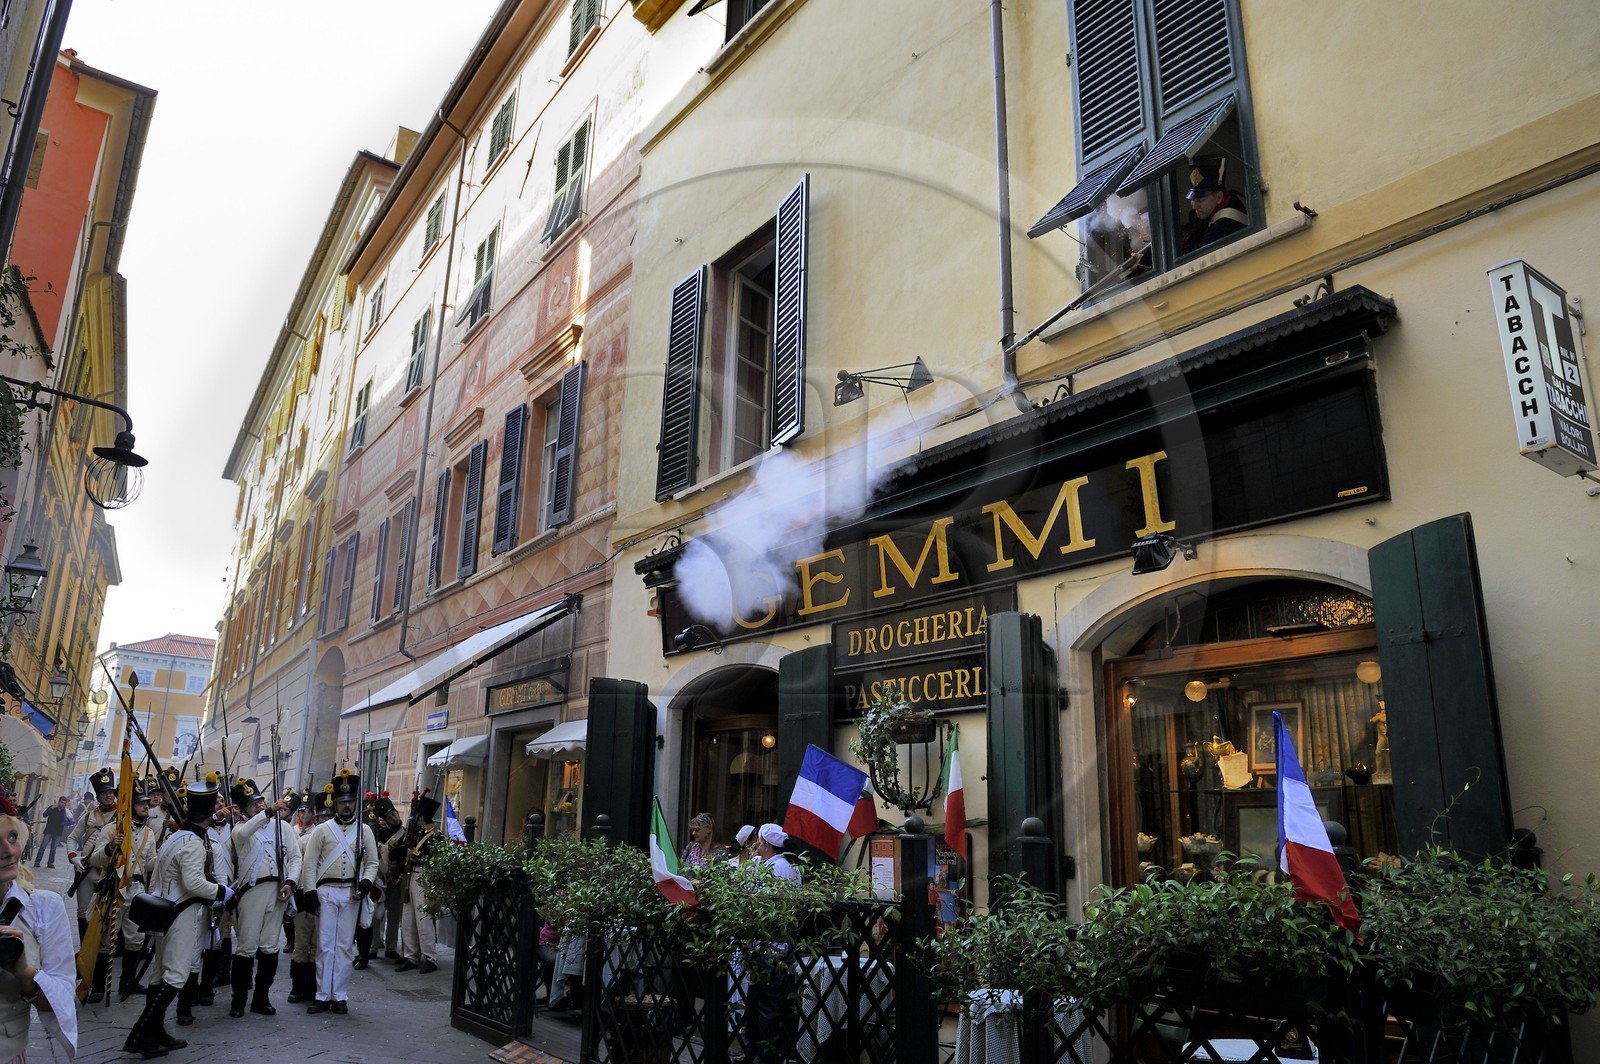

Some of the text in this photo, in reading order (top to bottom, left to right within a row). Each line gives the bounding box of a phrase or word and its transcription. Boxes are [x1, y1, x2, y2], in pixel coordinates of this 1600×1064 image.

[1500, 274, 1539, 438] TABACCHI
[1551, 375, 1573, 397] SALI E
[1567, 366, 1576, 381] 2
[1545, 382, 1589, 424] TABACCHI
[1558, 418, 1584, 442] VALORI
[1560, 432, 1589, 457] BOLLATI
[847, 604, 988, 657] DROGHERIA
[843, 666, 987, 711] PASTICCERI
